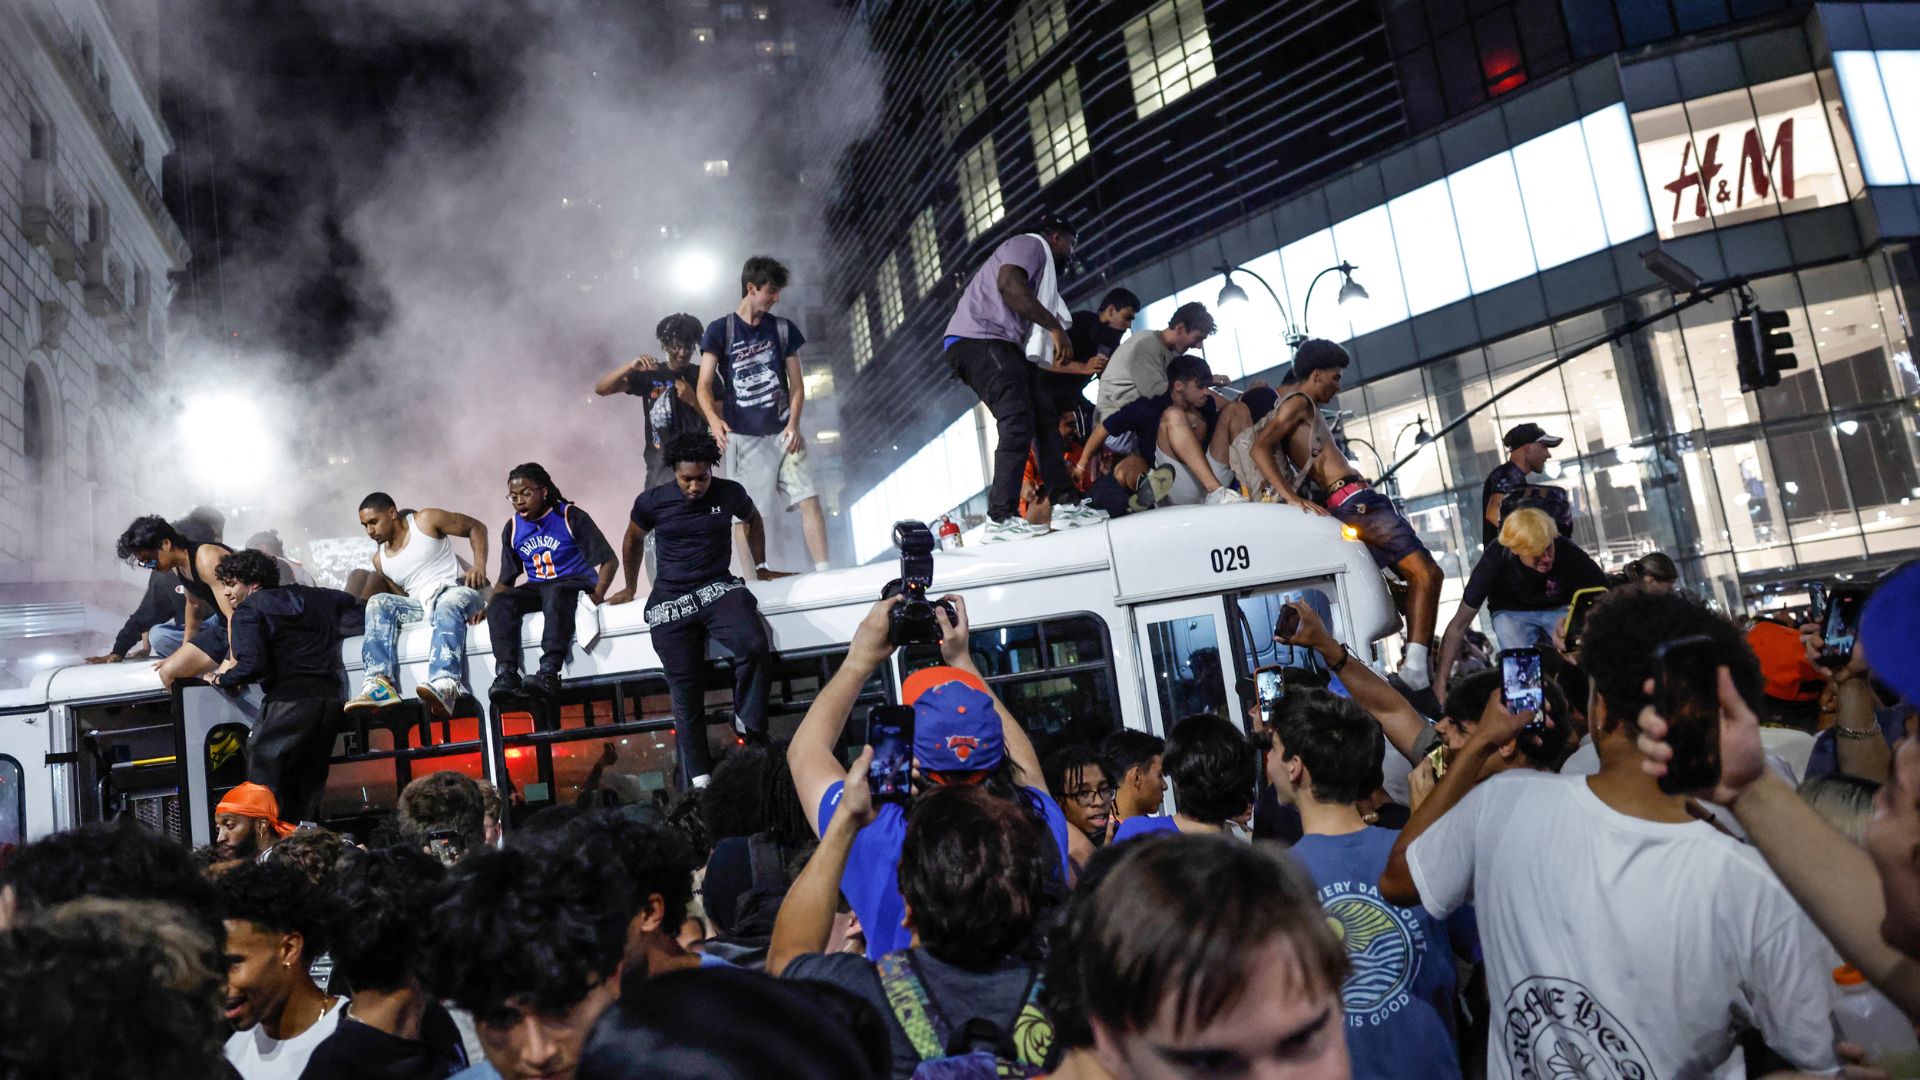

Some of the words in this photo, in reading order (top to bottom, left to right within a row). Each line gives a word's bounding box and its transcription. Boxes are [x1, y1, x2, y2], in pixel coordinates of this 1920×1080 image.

[1664, 117, 1795, 222] H&M
[520, 535, 560, 556] BRUNSON
[1210, 545, 1250, 573] 029
[532, 551, 558, 579] 11
[1359, 882, 1384, 901] DA
[1393, 905, 1427, 952] OUNT
[1350, 1015, 1364, 1027] IS
[1370, 993, 1409, 1026] GOOD
